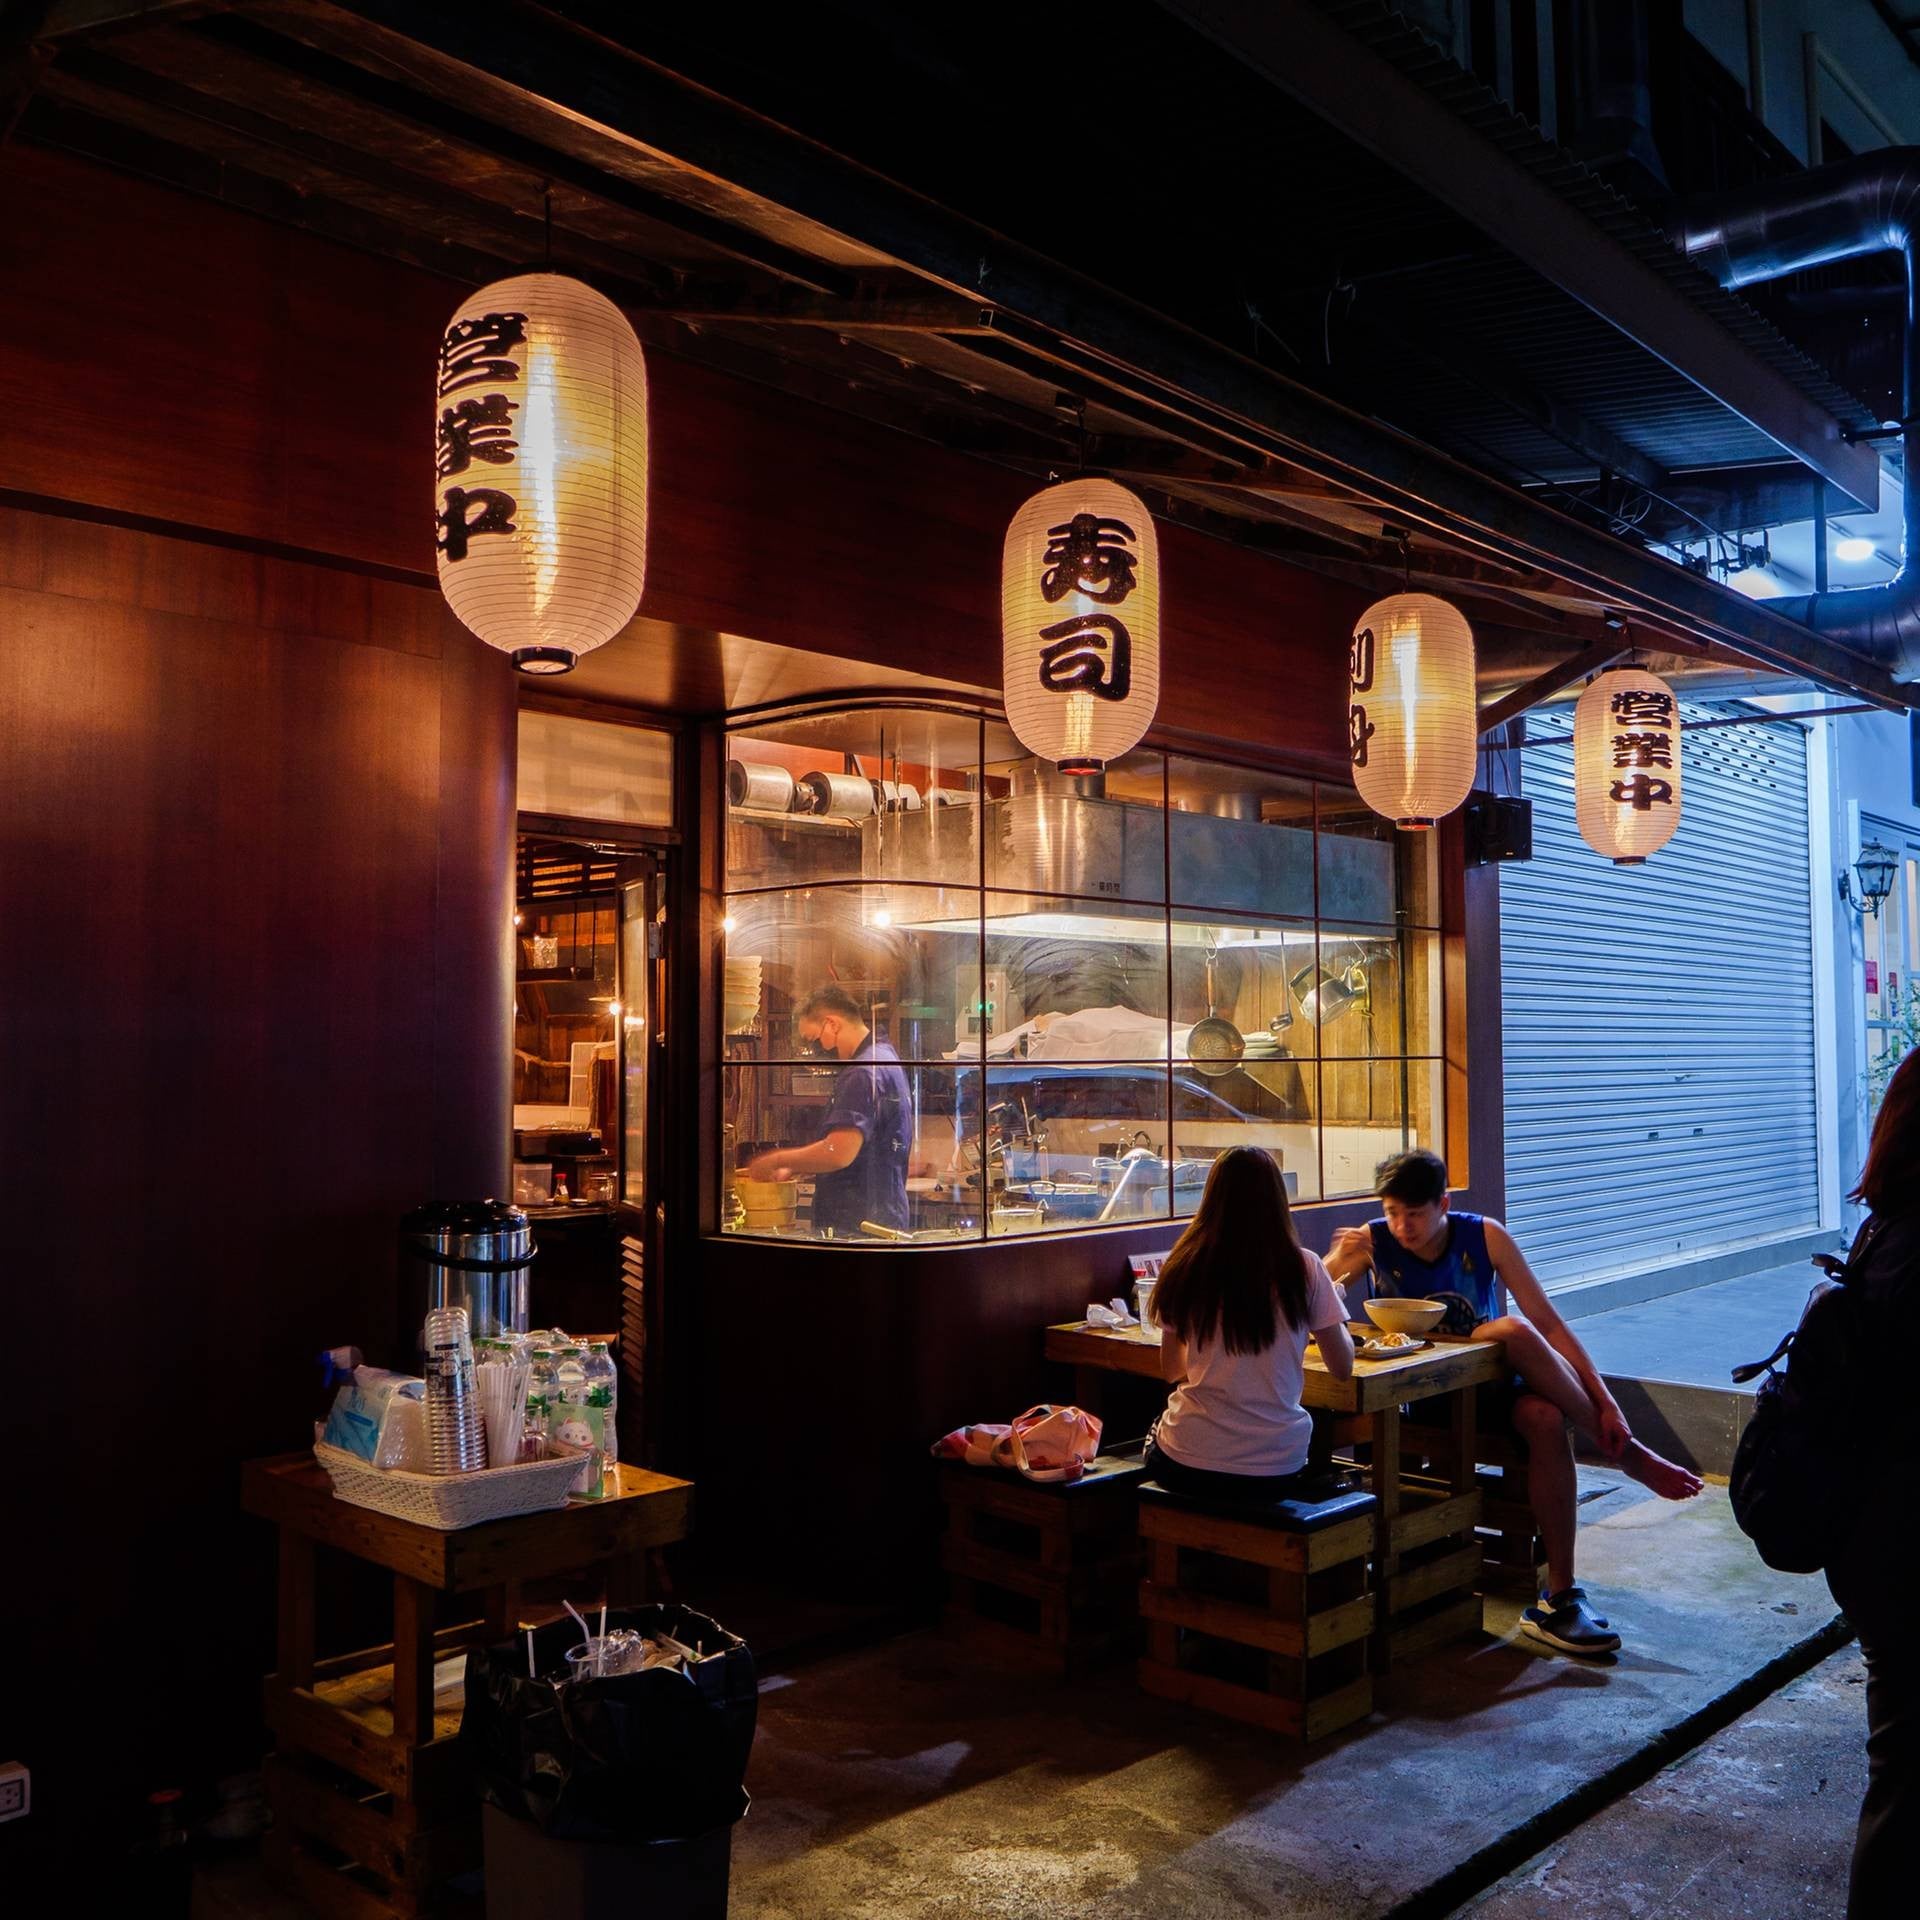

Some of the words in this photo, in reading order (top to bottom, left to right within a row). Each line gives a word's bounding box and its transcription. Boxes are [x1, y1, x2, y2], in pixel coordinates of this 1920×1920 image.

[1038, 513, 1139, 703] 寿司
[1609, 690, 1673, 811] 営業中
